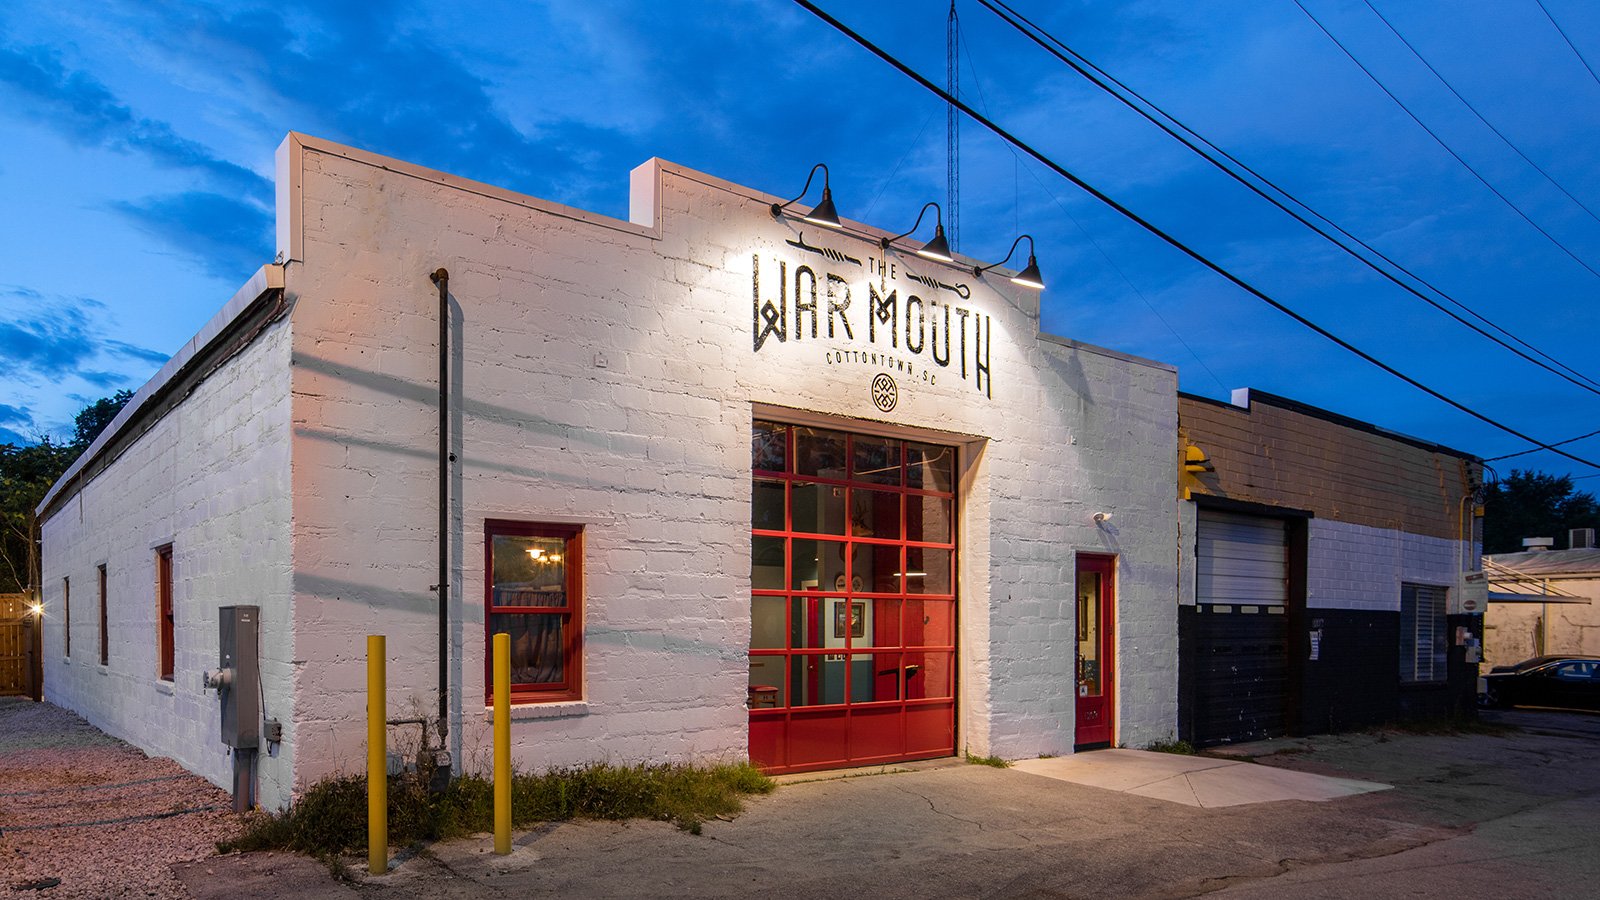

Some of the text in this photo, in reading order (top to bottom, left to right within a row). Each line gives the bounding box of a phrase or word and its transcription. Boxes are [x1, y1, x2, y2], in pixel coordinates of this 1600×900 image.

[869, 256, 896, 280] THE
[754, 254, 990, 399] WAR MOUTH
